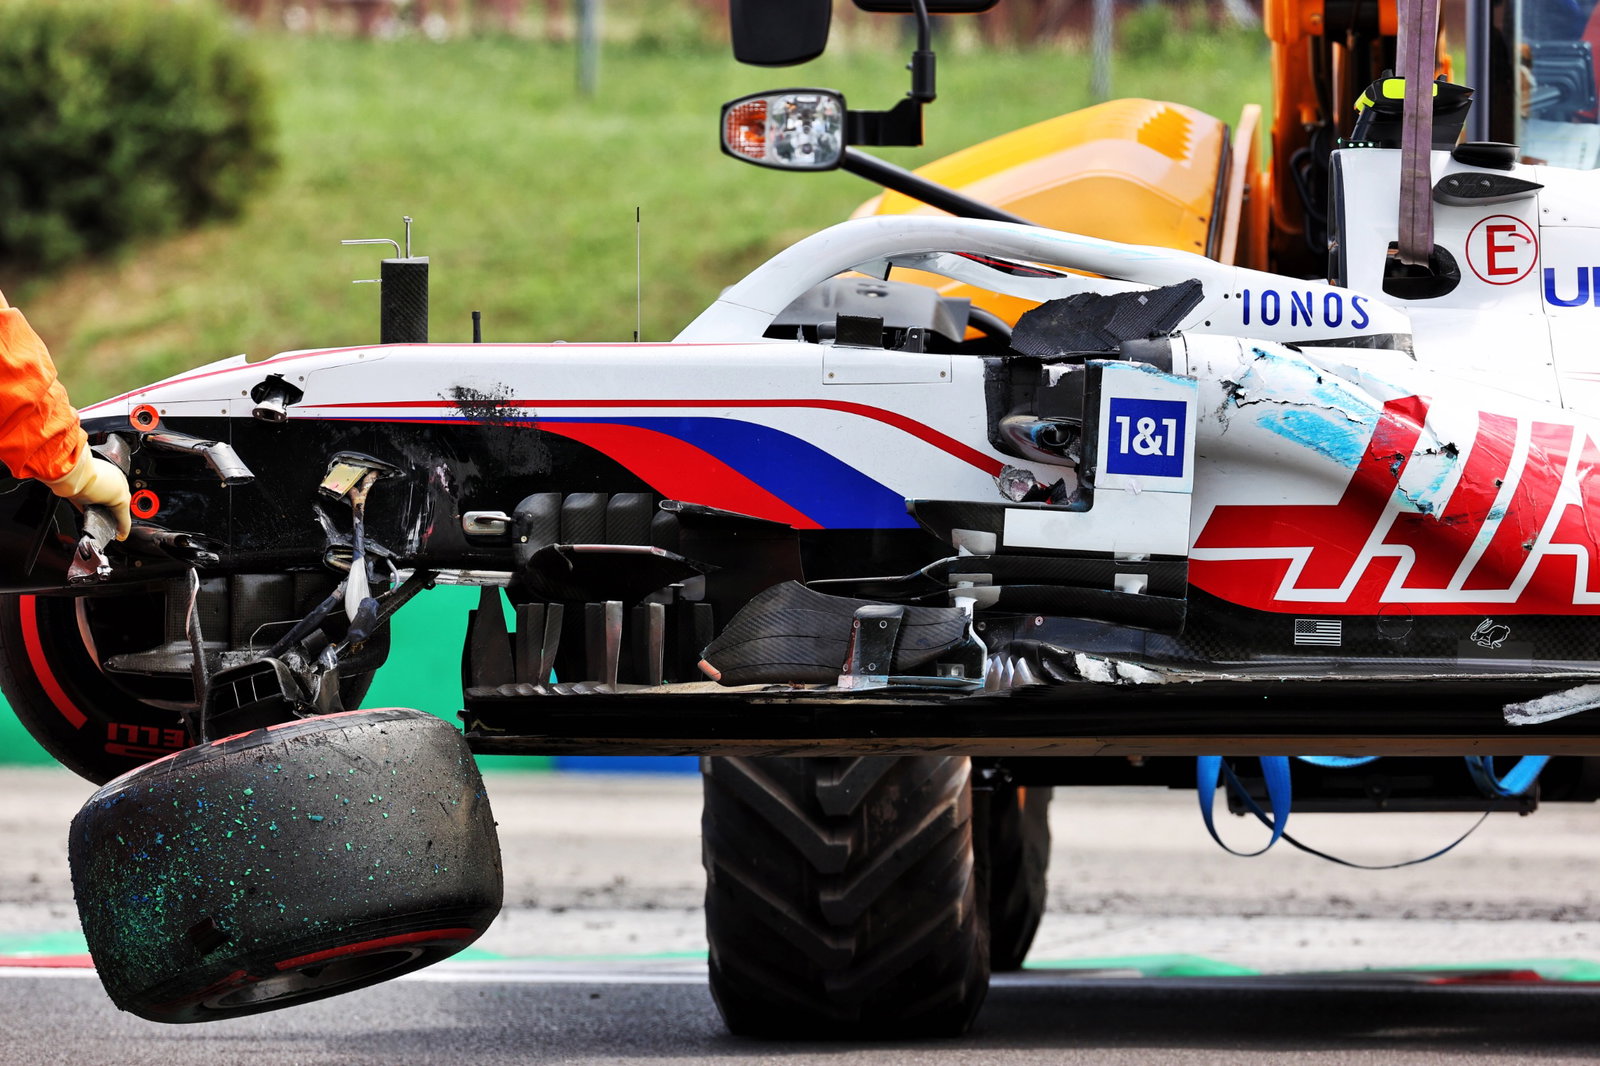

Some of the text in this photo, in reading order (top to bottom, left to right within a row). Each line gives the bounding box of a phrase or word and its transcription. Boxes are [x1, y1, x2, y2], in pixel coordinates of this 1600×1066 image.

[1486, 225, 1519, 276] E
[1242, 289, 1370, 329] IONOS
[1115, 416, 1178, 457] 1&1
[107, 722, 196, 748] ELLI
